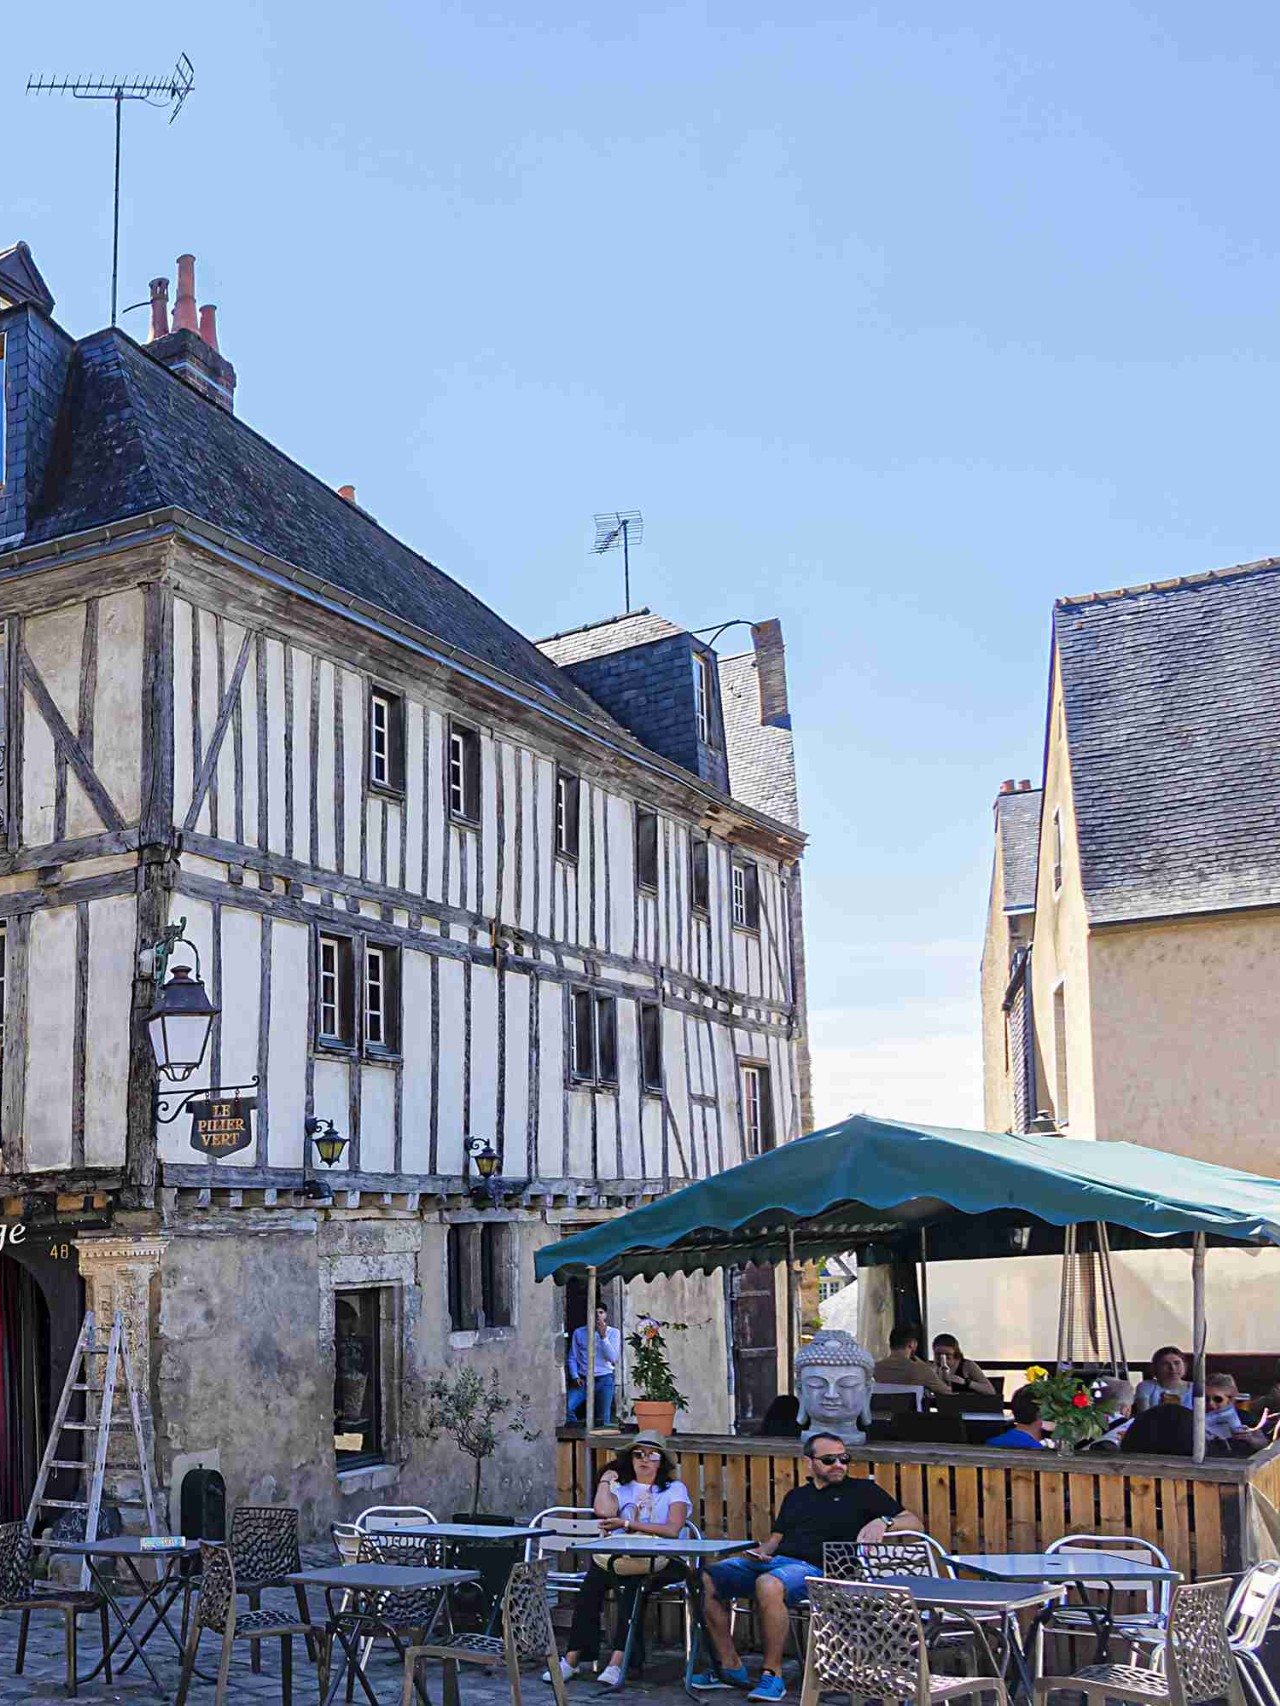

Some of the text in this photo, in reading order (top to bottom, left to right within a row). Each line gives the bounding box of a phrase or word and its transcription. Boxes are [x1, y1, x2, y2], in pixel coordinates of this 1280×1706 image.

[212, 1104, 231, 1118] LE
[198, 1118, 246, 1133] PILIER
[201, 1133, 240, 1148] VERT
[50, 1244, 68, 1259] 48
